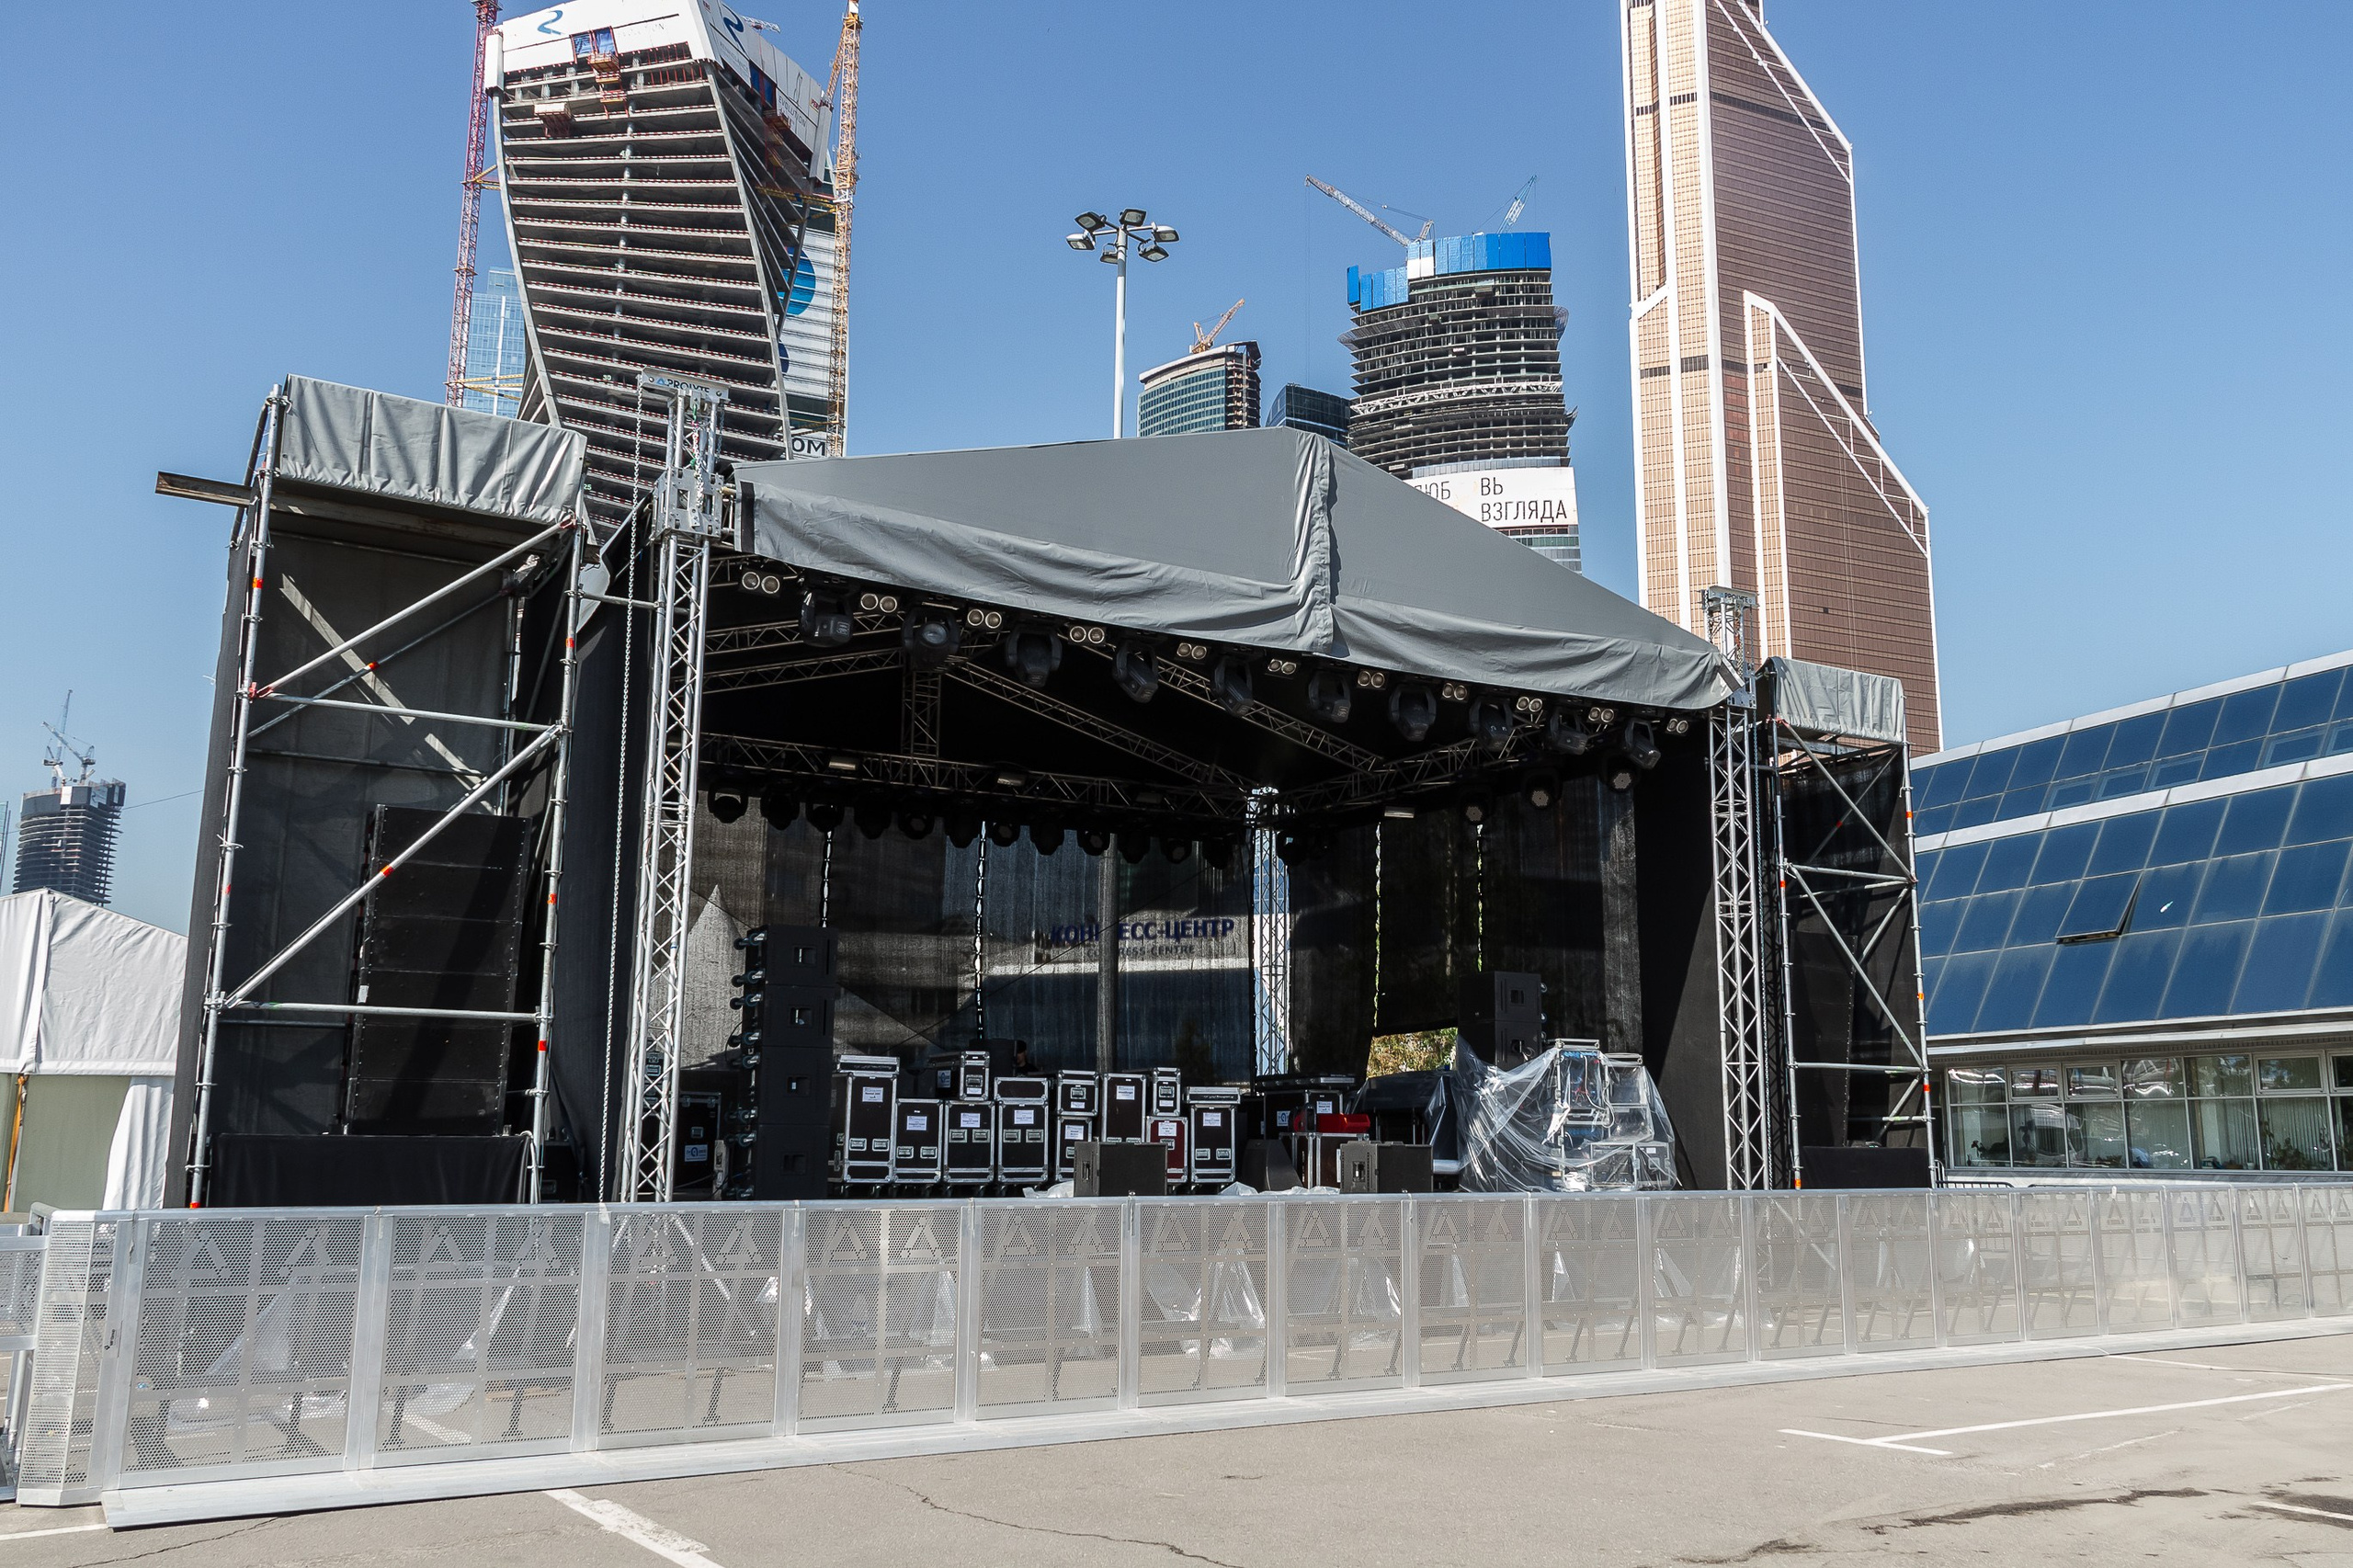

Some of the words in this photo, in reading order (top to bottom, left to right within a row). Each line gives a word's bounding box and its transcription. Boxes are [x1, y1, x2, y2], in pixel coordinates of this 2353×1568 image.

[1481, 499, 1567, 523] ВЗГЛЯДА
[1051, 918, 1235, 946] КОНЕСС-ЦЕНТР
[1151, 944, 1197, 957] CENTRE
